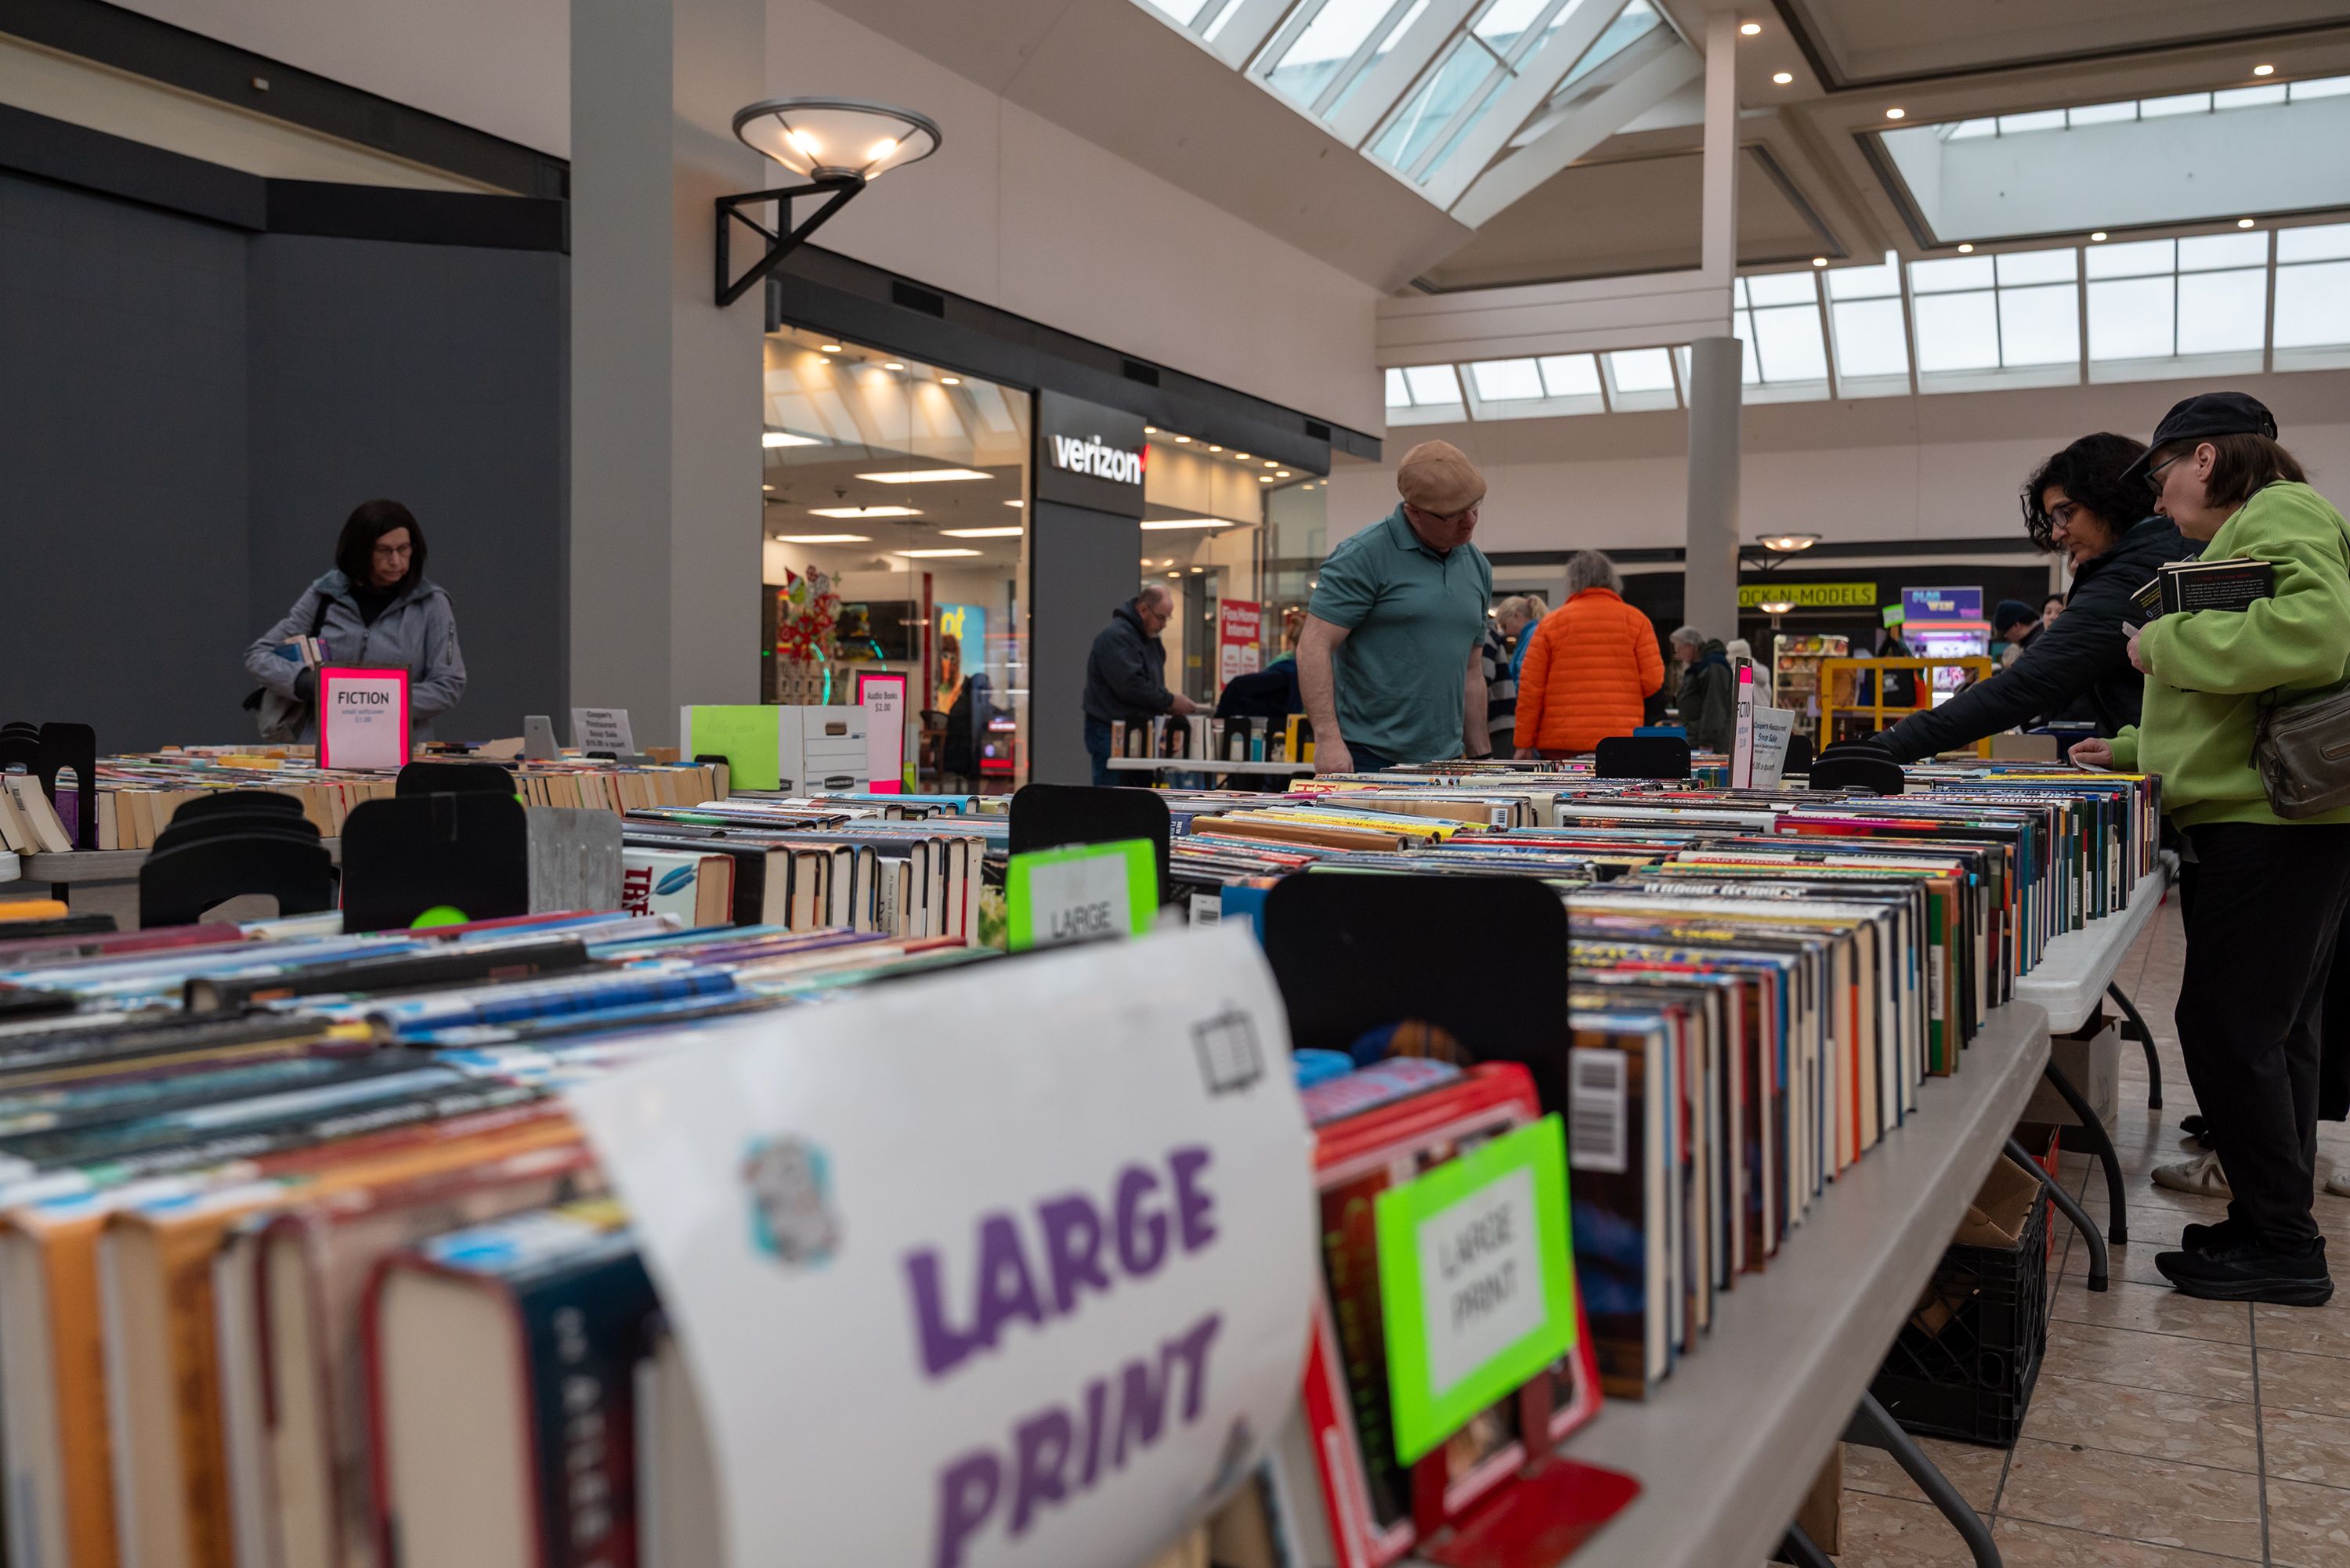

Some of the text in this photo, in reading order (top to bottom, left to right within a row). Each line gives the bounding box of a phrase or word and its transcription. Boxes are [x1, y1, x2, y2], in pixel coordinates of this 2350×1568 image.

[1054, 434, 1141, 485] verizon
[1738, 587, 1871, 605] OCK-N-MODELS
[338, 692, 389, 704] FICTION
[875, 703, 891, 712] $2.00
[1737, 702, 1751, 719] FICTIO
[1754, 721, 1769, 731] Cooper's
[1758, 732, 1778, 742] Soup Sale
[1763, 763, 1775, 771] quart
[1050, 901, 1112, 938] LARGE
[1437, 1201, 1515, 1281] LARGE
[901, 1143, 1220, 1385] LARGE
[1451, 1258, 1520, 1330] PRINT
[932, 1310, 1225, 1568] PRINT
